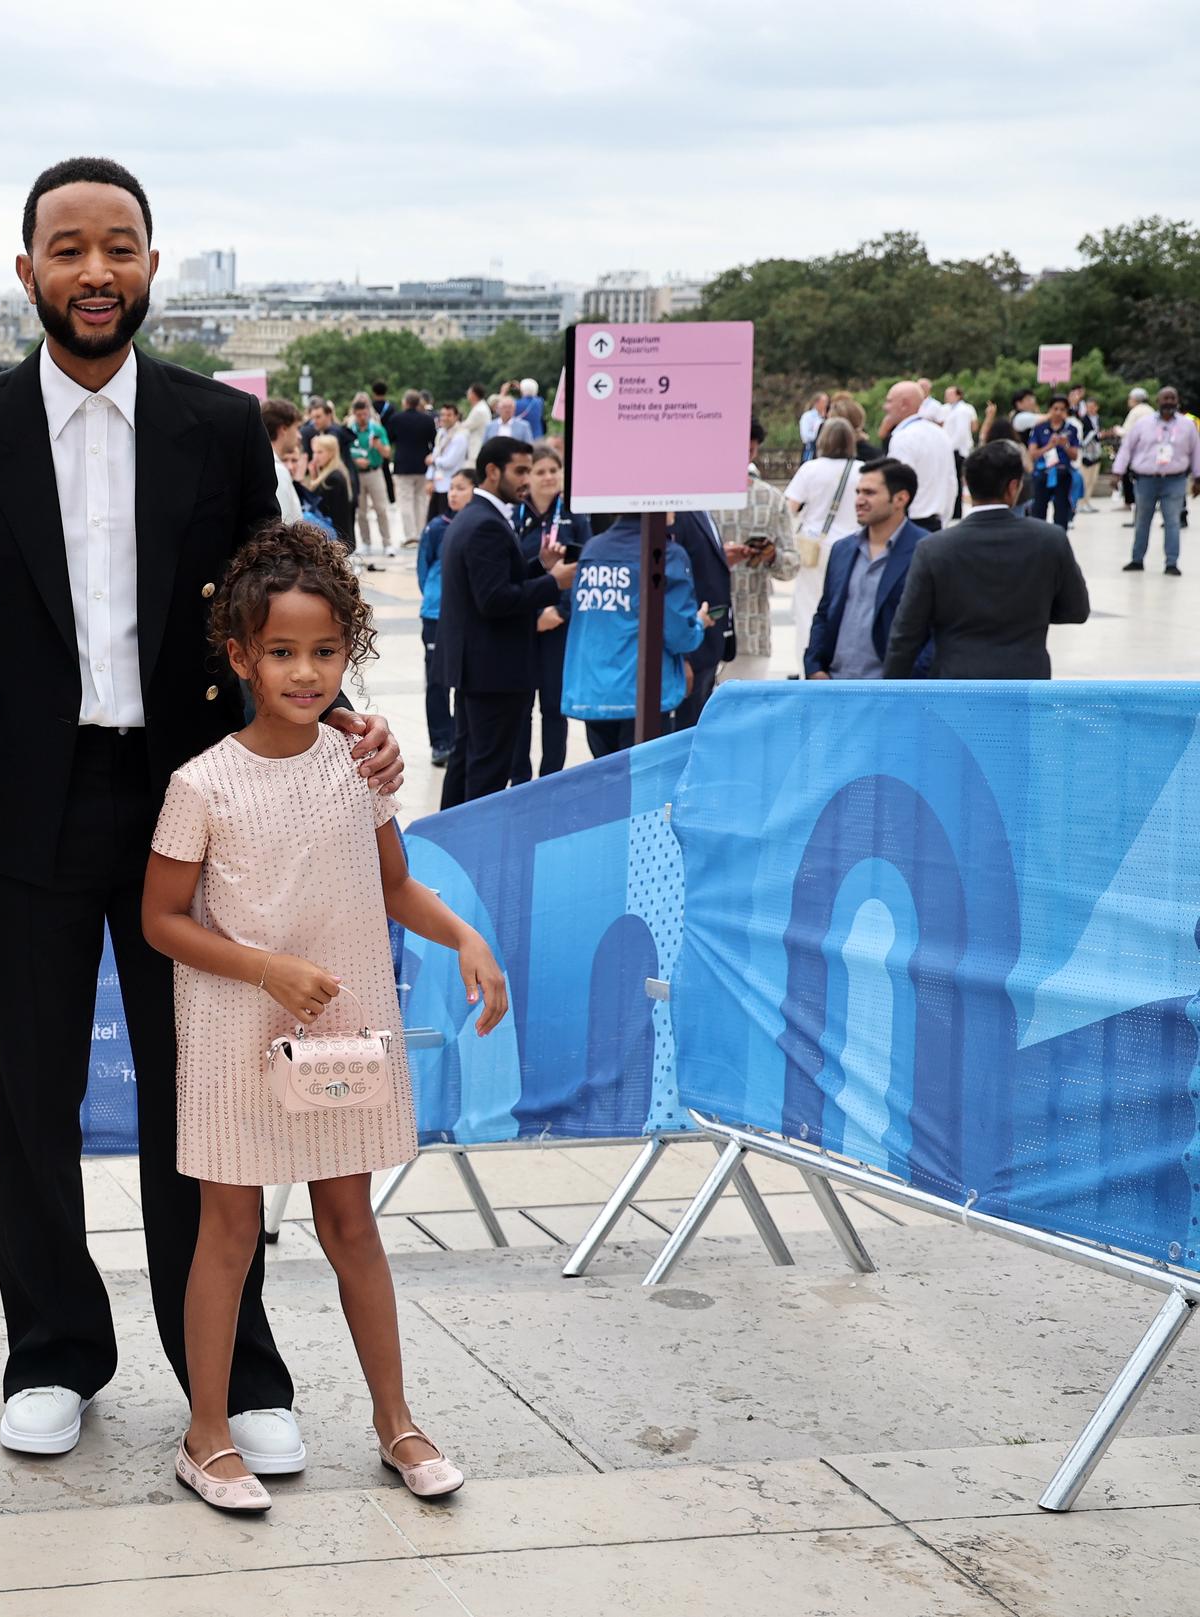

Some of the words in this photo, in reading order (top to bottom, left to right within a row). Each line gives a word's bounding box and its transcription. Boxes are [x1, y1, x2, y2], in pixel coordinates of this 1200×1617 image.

[620, 336, 660, 345] Aquarium
[620, 346, 659, 354] Aquarium
[619, 376, 646, 384] Entrée
[658, 375, 670, 394] 9
[618, 387, 654, 395] Entrance
[618, 402, 646, 411] Invités
[648, 402, 662, 410] des
[664, 402, 698, 412] parrains
[618, 412, 660, 421] Presenting
[662, 412, 694, 420] Partners
[696, 411, 723, 420] Guests
[576, 588, 631, 612] 2024
[91, 1022, 117, 1040] tel
